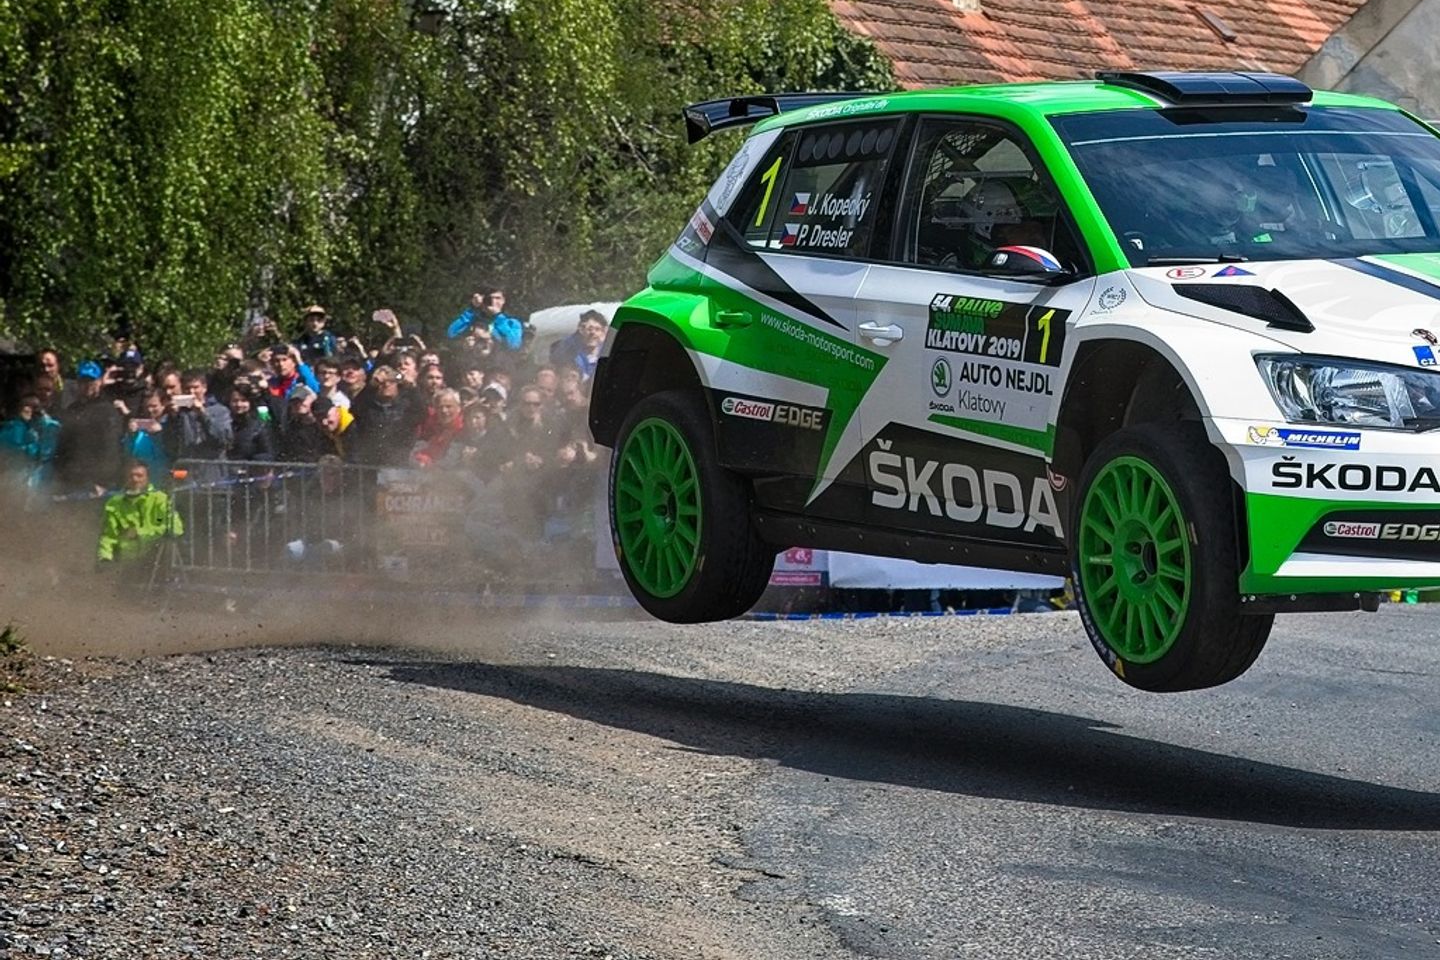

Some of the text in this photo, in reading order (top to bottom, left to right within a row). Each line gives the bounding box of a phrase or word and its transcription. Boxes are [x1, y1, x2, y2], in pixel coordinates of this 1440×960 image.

[755, 156, 783, 227] 1
[808, 192, 872, 222] J. Kopecký
[796, 225, 853, 248] P. Dresler
[760, 312, 875, 371] www.skoda-motorsport.com
[927, 329, 1021, 358] KLATOVY 2019
[1038, 309, 1056, 363] 1
[959, 361, 1053, 396] AUTO NEJDL
[735, 401, 824, 430] Castrol EDGE
[958, 390, 1007, 421] Klatovy
[1287, 433, 1360, 445] MICHELIN
[869, 438, 1065, 539] ŠKODA
[1337, 523, 1377, 537] Castrol
